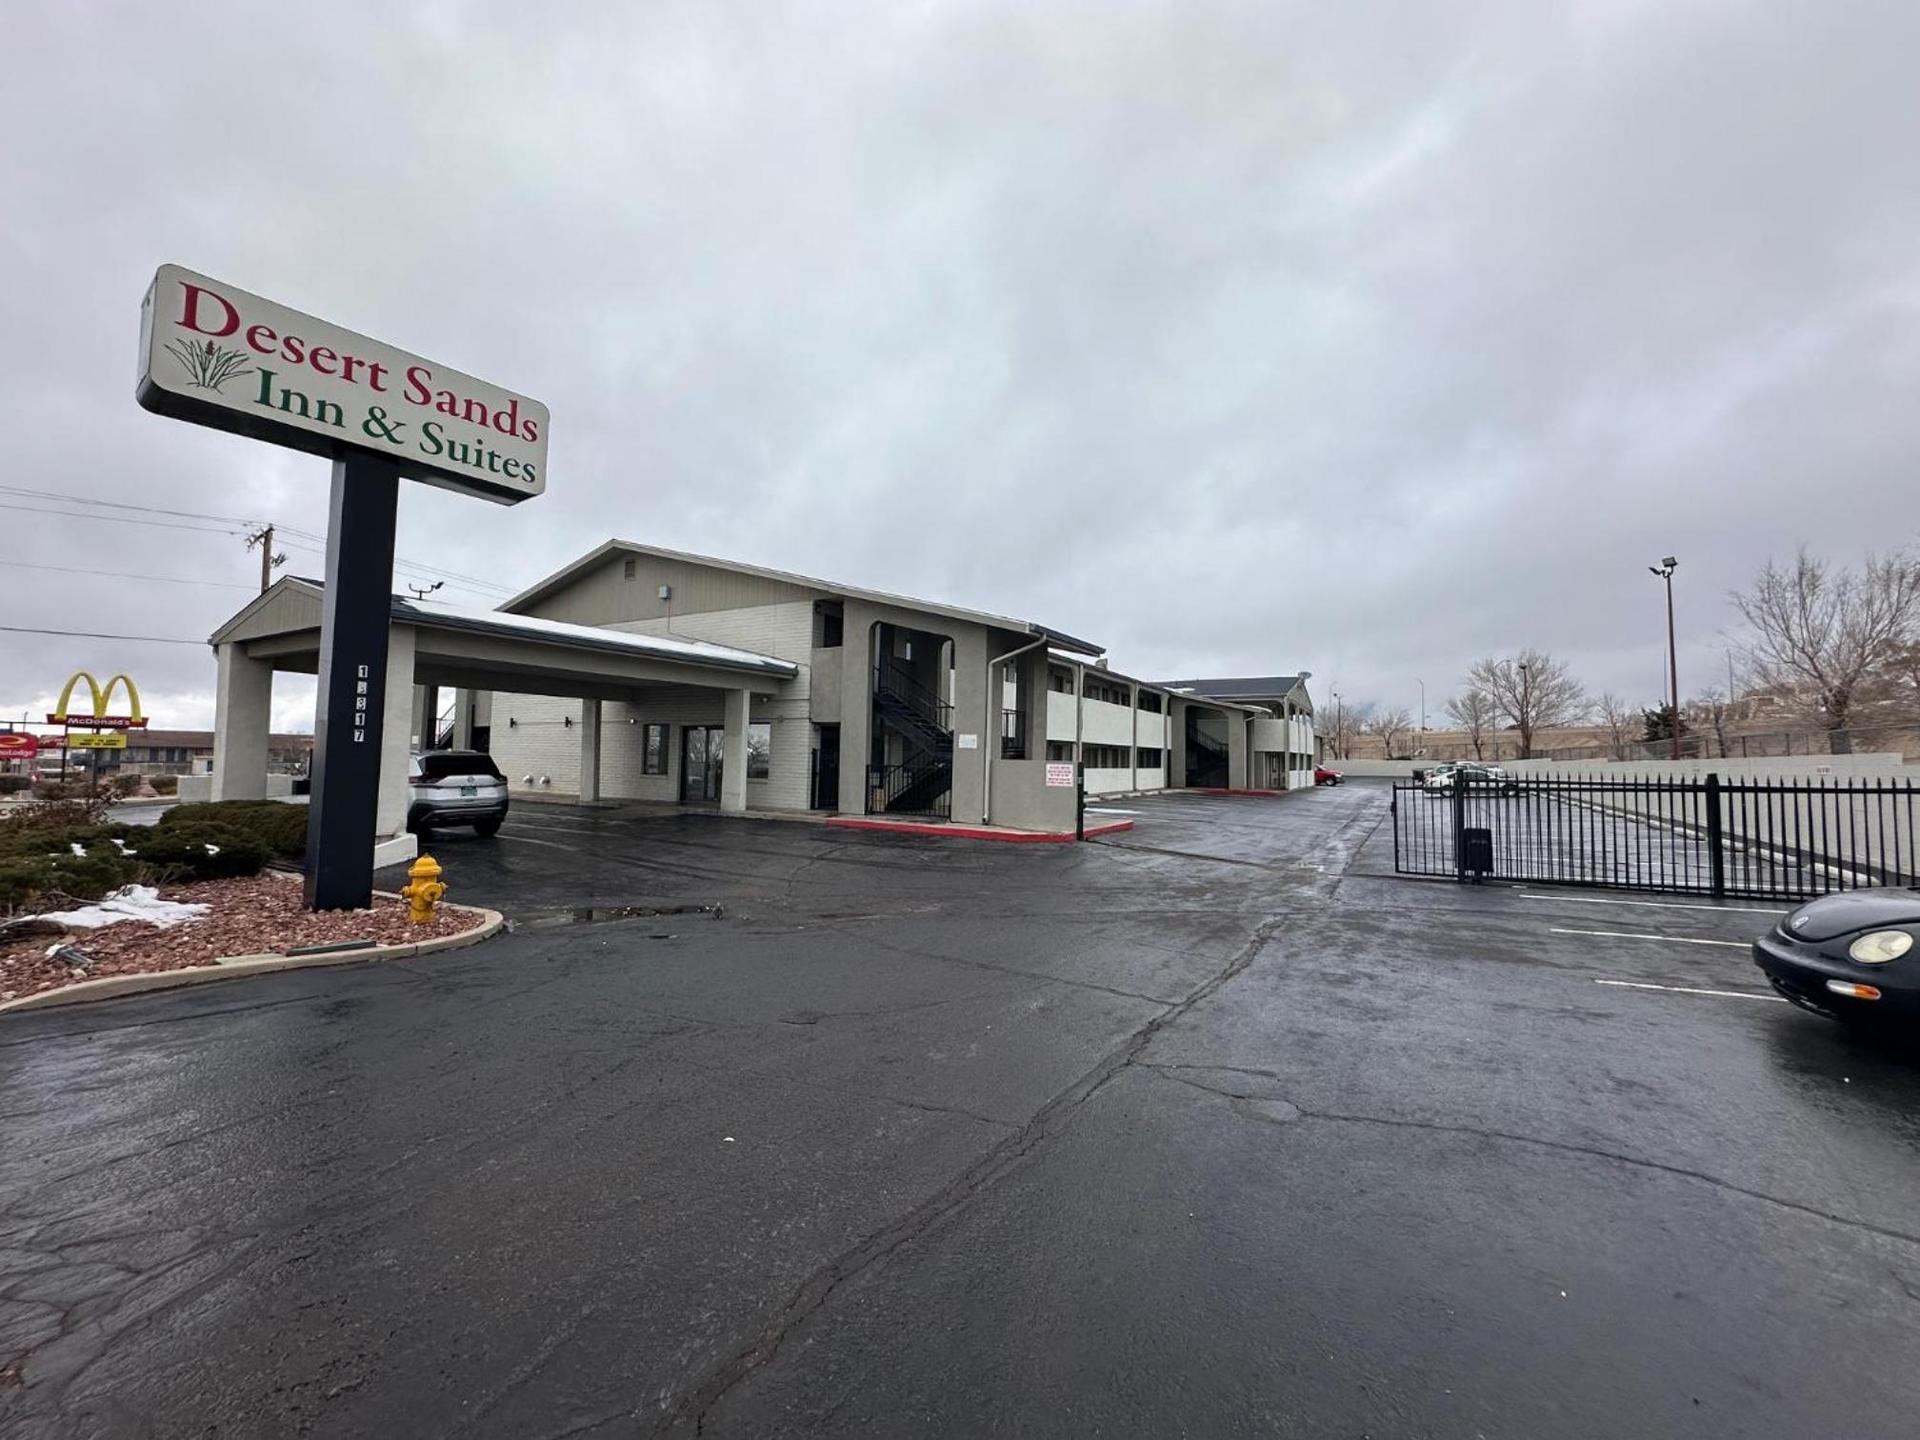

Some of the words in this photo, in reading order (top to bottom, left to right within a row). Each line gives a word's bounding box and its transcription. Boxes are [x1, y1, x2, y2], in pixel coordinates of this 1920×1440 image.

[175, 281, 389, 392] Desert
[404, 365, 539, 442] Sands
[254, 367, 347, 429] Inn
[362, 406, 408, 445] &
[420, 422, 537, 483] Suites
